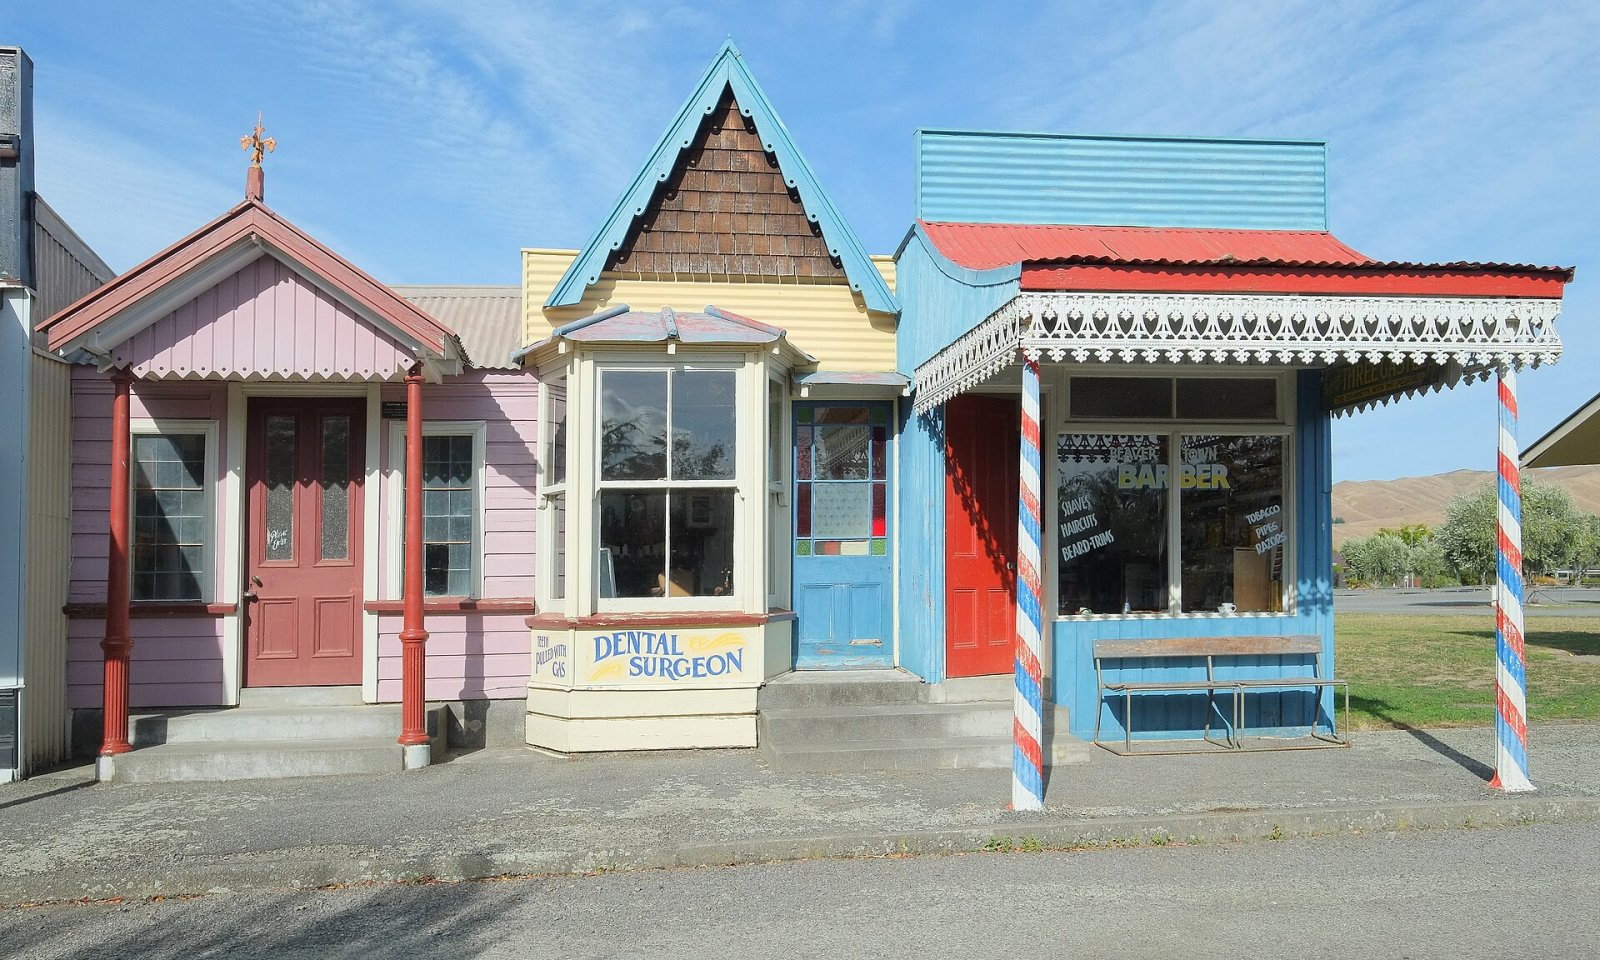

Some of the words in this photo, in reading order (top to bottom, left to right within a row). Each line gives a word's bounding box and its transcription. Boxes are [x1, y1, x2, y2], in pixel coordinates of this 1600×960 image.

[1109, 447, 1157, 461] BEAVER
[1183, 445, 1218, 461] TOWN
[1061, 494, 1092, 517] SHAVES
[1246, 504, 1281, 525] TOBACCO
[1060, 512, 1098, 538] HAIRCUTS
[1255, 521, 1279, 539] PIPES
[1255, 531, 1287, 555] RAZORS
[537, 635, 549, 648] TEETH
[593, 631, 684, 664] DENTAL
[535, 647, 554, 674] PULLED
[553, 644, 567, 659] WITH
[552, 661, 566, 678] GAS
[629, 647, 744, 681] SURGEON
